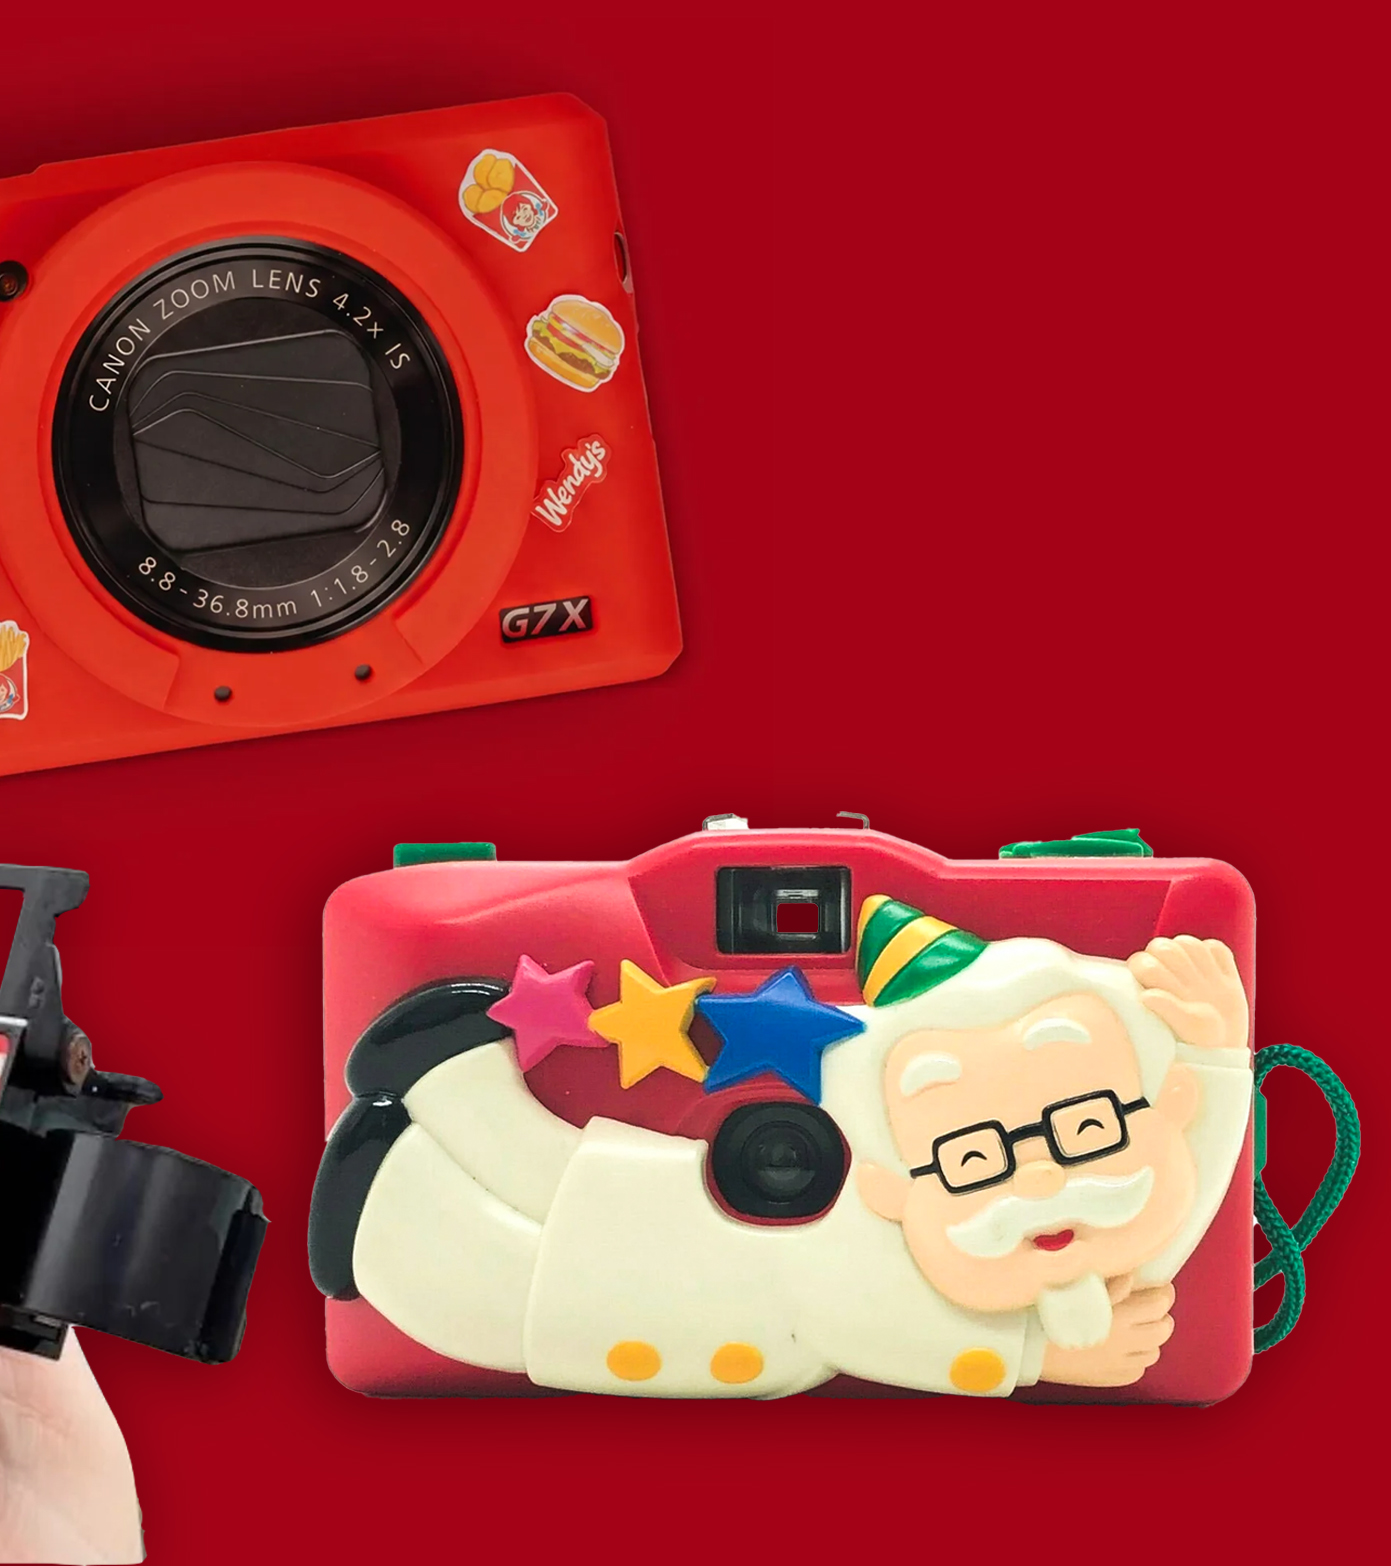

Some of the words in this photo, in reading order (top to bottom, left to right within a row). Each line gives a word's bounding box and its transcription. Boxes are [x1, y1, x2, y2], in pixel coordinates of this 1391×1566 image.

[89, 318, 151, 412] CANON
[152, 271, 236, 320] ZOOM
[252, 269, 321, 298] LENS
[385, 343, 411, 370] IS
[534, 440, 606, 526] Wendy's
